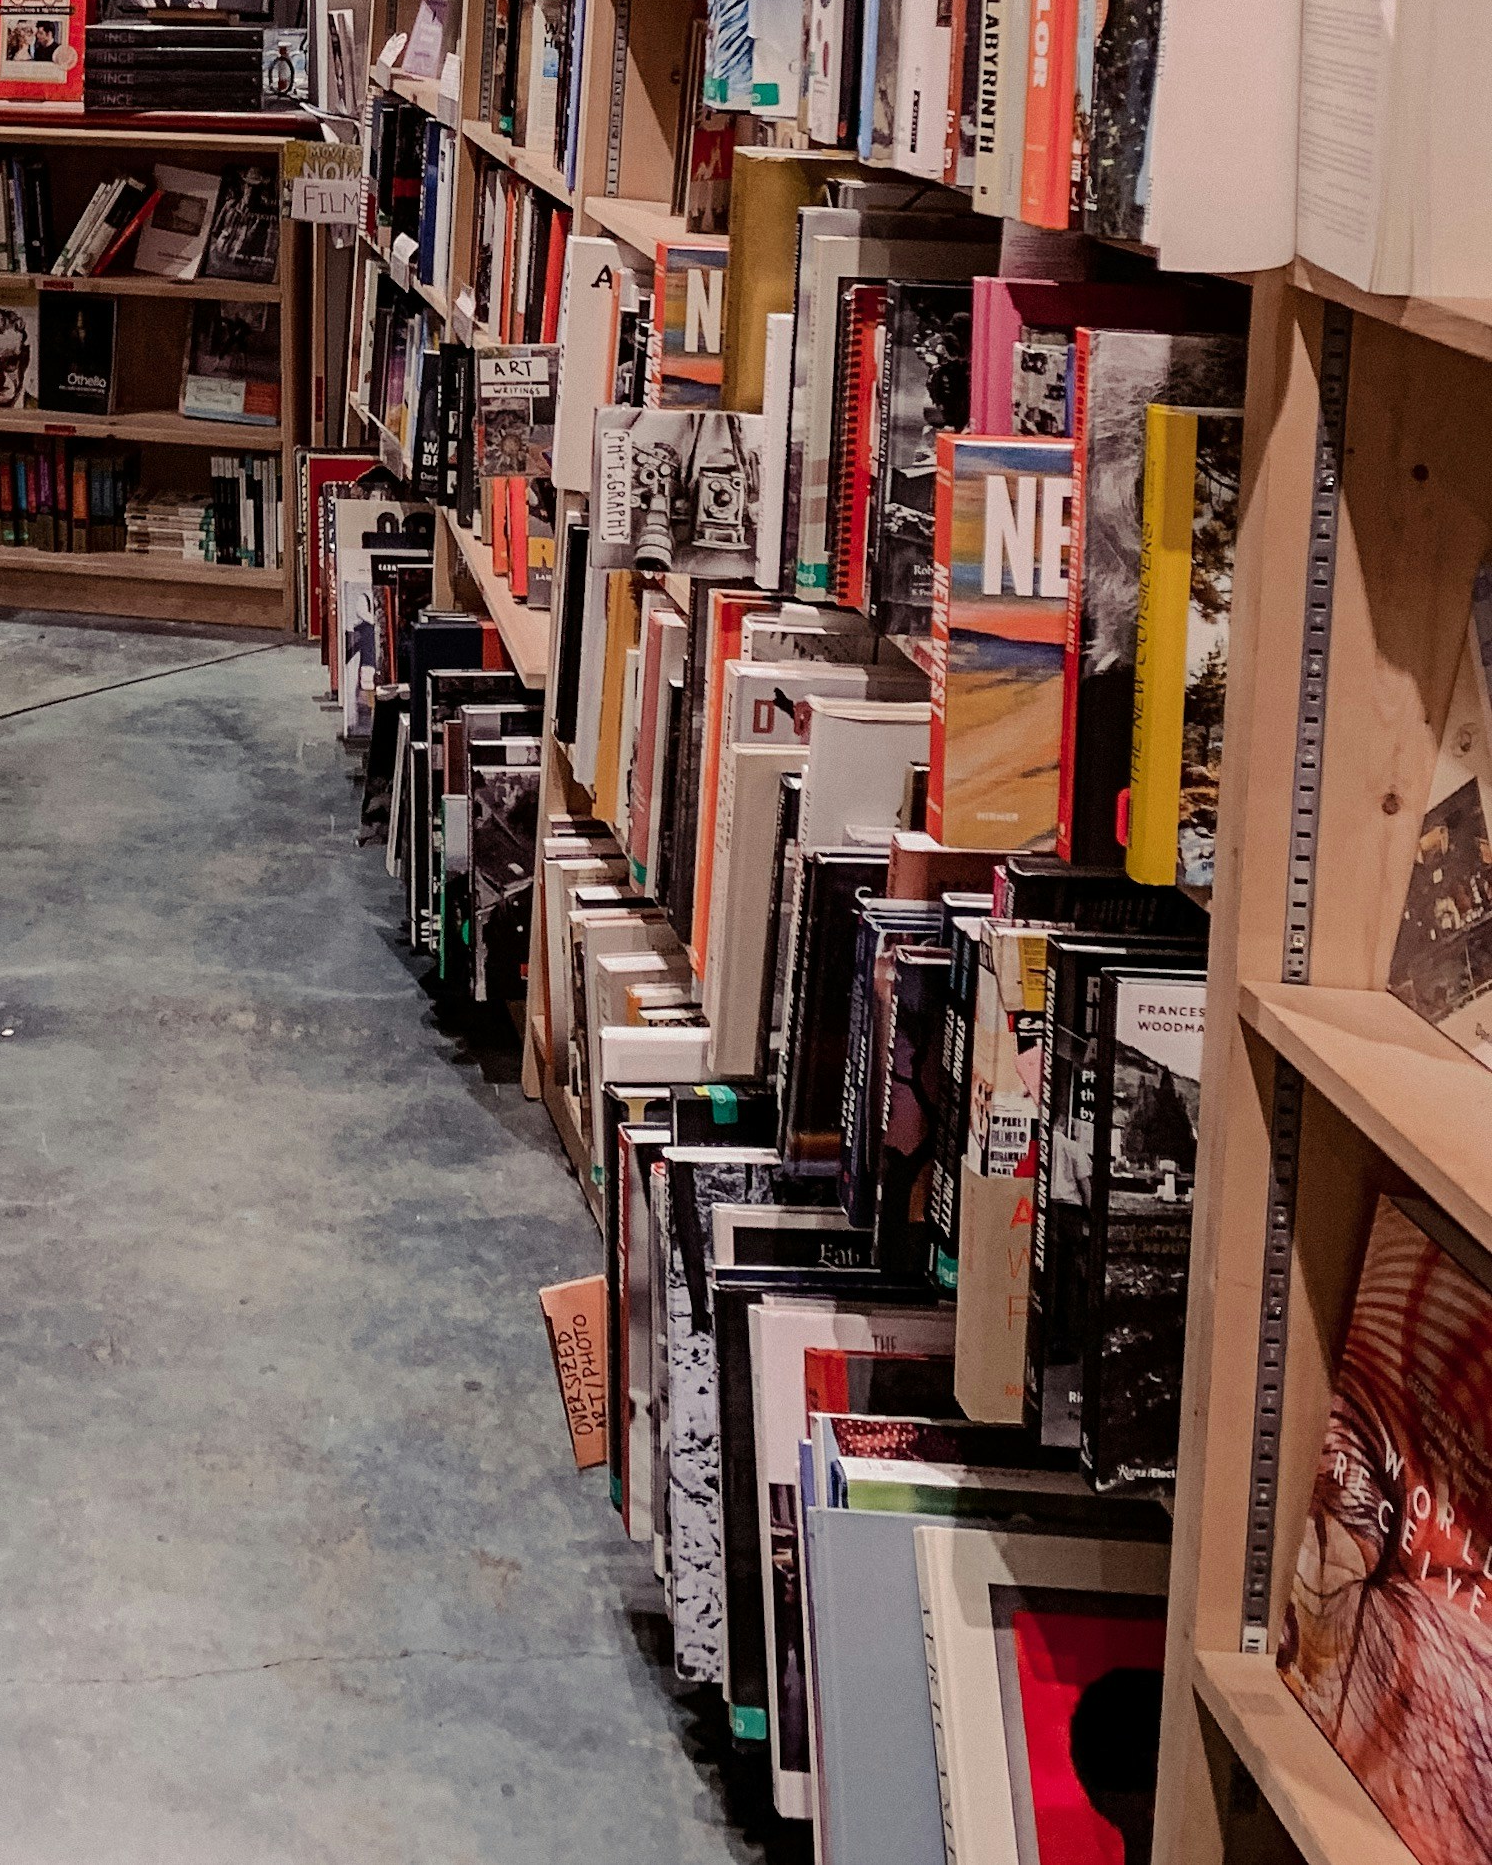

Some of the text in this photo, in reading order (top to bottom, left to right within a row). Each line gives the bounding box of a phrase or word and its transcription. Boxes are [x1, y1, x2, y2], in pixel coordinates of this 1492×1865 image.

[304, 183, 359, 215] FILM
[67, 372, 107, 389] Othello
[493, 385, 541, 396] WRITINGS
[494, 359, 533, 378] ART
[929, 561, 950, 726] NEW WEST
[1130, 521, 1154, 783] THE NEW OUTSIDERS
[1042, 965, 1056, 1078] REVOLUTION
[880, 994, 899, 1133] TERRA FLAMMA
[930, 1003, 955, 1225] STRONG PRETTY
[940, 1015, 967, 1239] STRONG PRETTY
[1039, 1108, 1051, 1164] BLACK
[1036, 1169, 1049, 1209] AND
[1034, 1212, 1047, 1273] WHITE
[872, 1335, 897, 1351] THE
[559, 1329, 591, 1437] OVERSIZED
